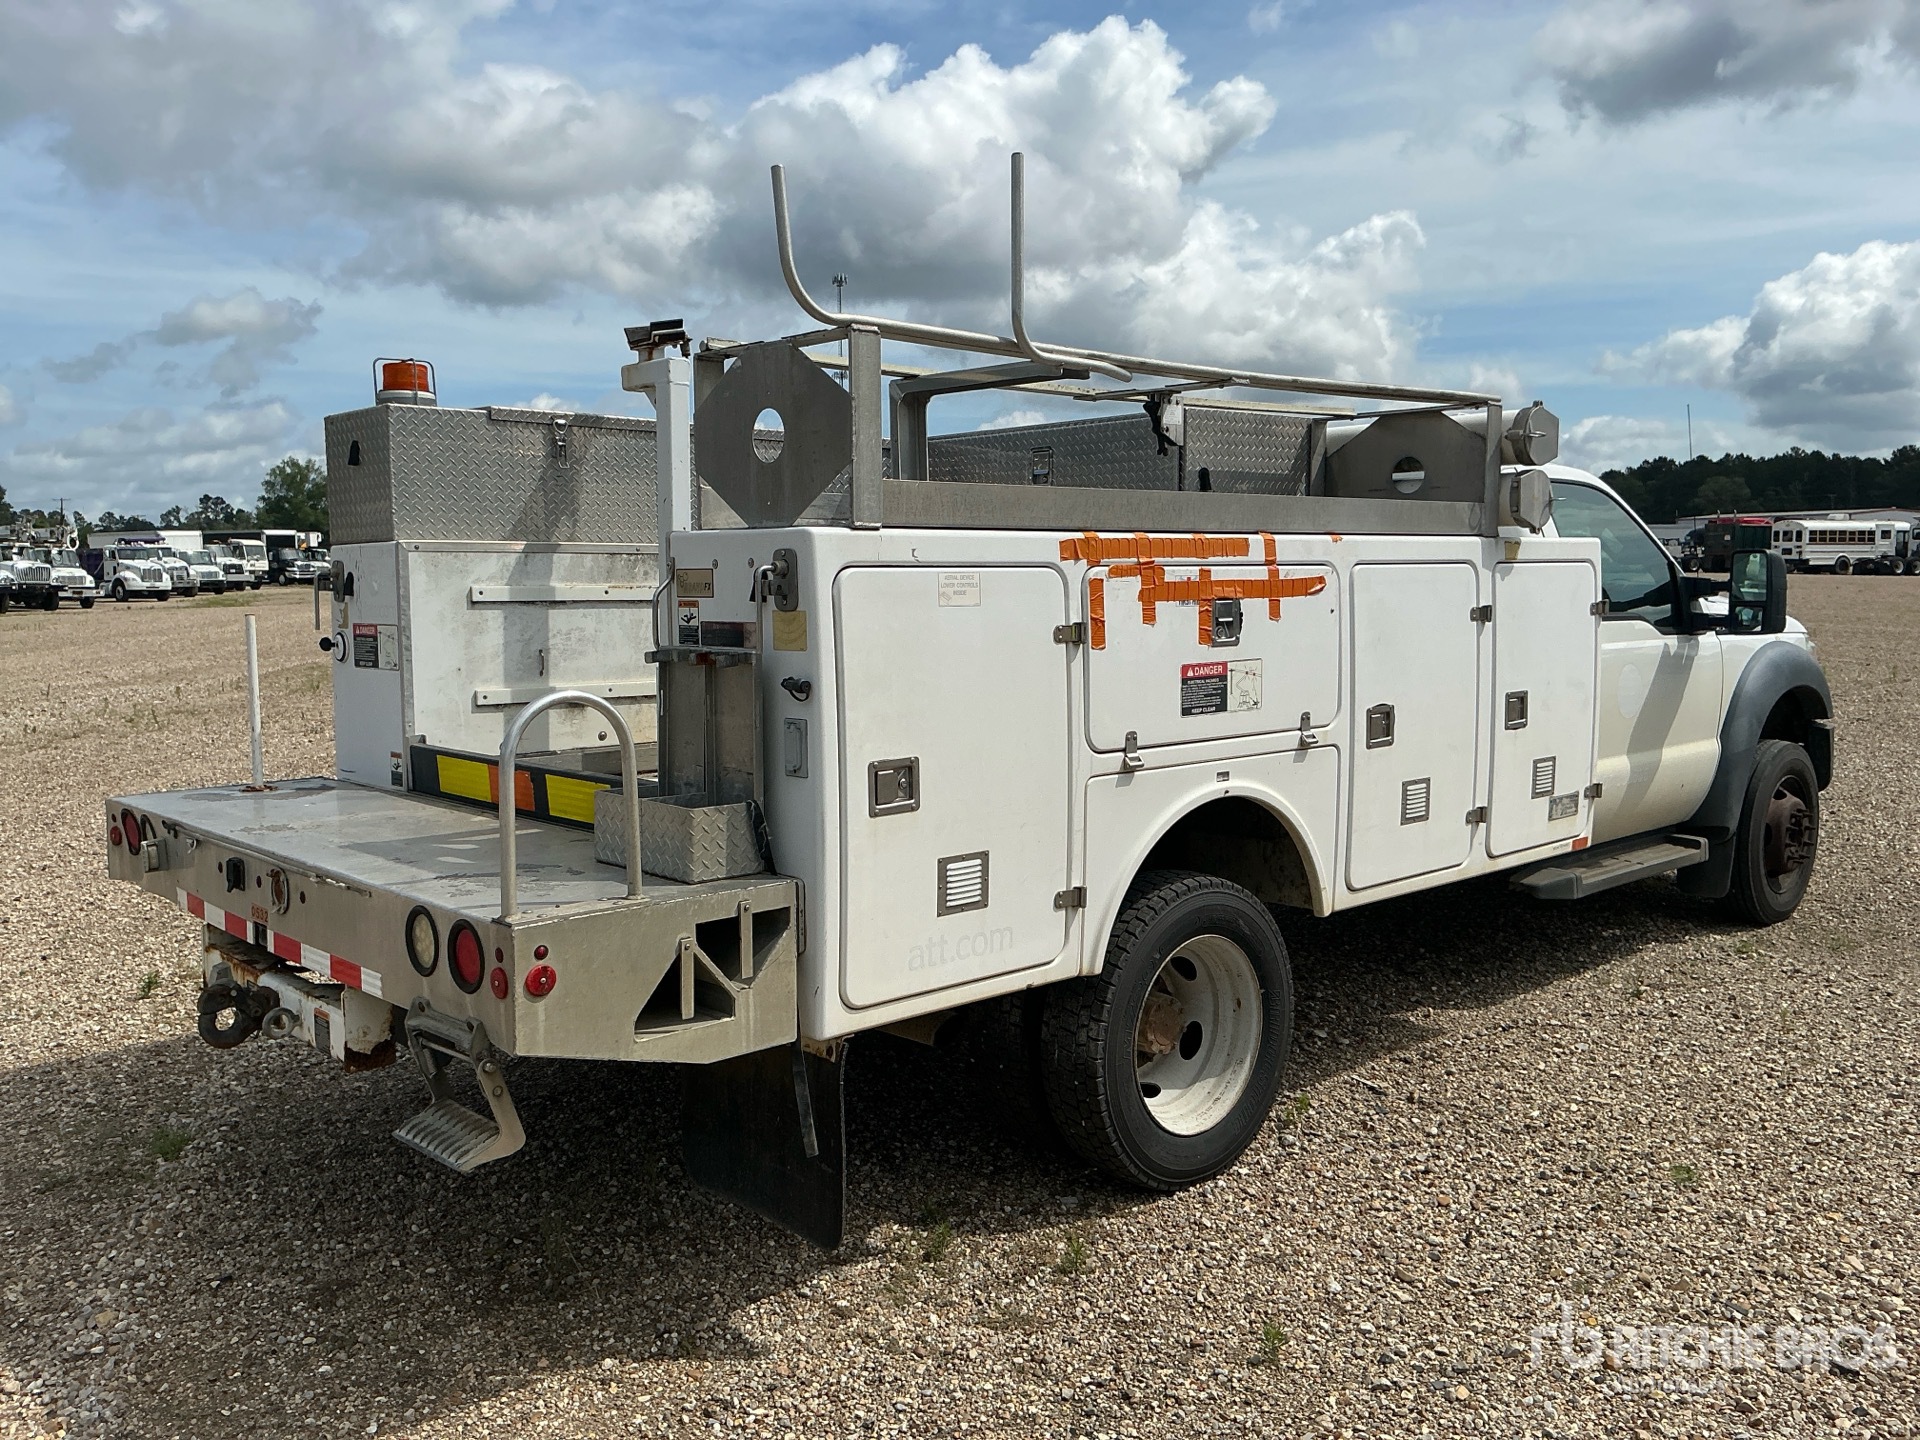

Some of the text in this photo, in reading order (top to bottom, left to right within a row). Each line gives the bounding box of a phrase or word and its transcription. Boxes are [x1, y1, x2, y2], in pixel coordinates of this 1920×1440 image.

[359, 626, 376, 635] DANGER
[1194, 665, 1223, 676] DANGER
[907, 926, 1014, 972] att.com
